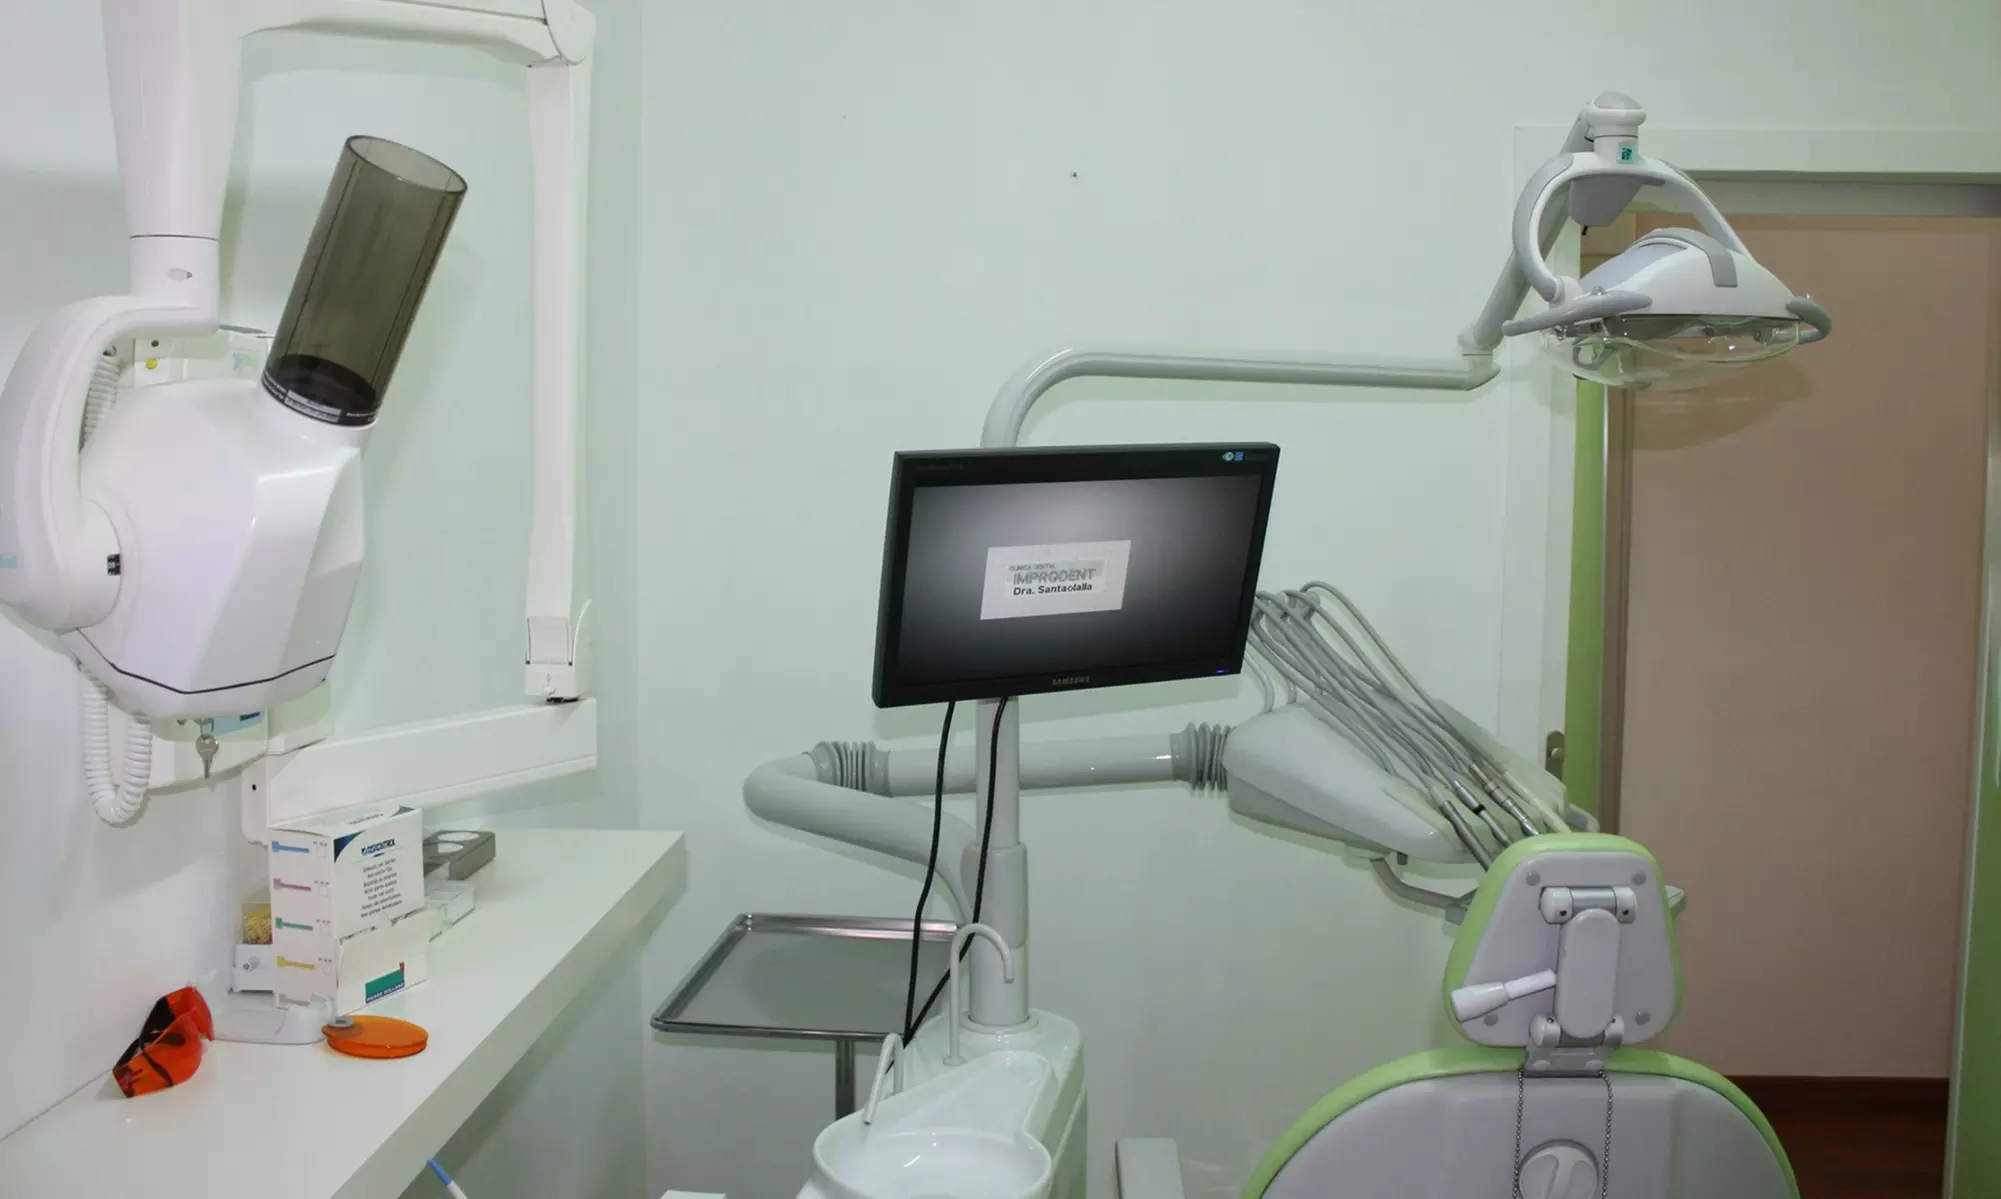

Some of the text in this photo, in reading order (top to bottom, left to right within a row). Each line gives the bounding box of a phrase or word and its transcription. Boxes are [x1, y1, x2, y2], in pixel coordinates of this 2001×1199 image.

[1013, 567, 1097, 585] IMPRODENT
[1013, 582, 1093, 596] Dra. Santaolalla
[1051, 675, 1090, 686] SAMSUNG
